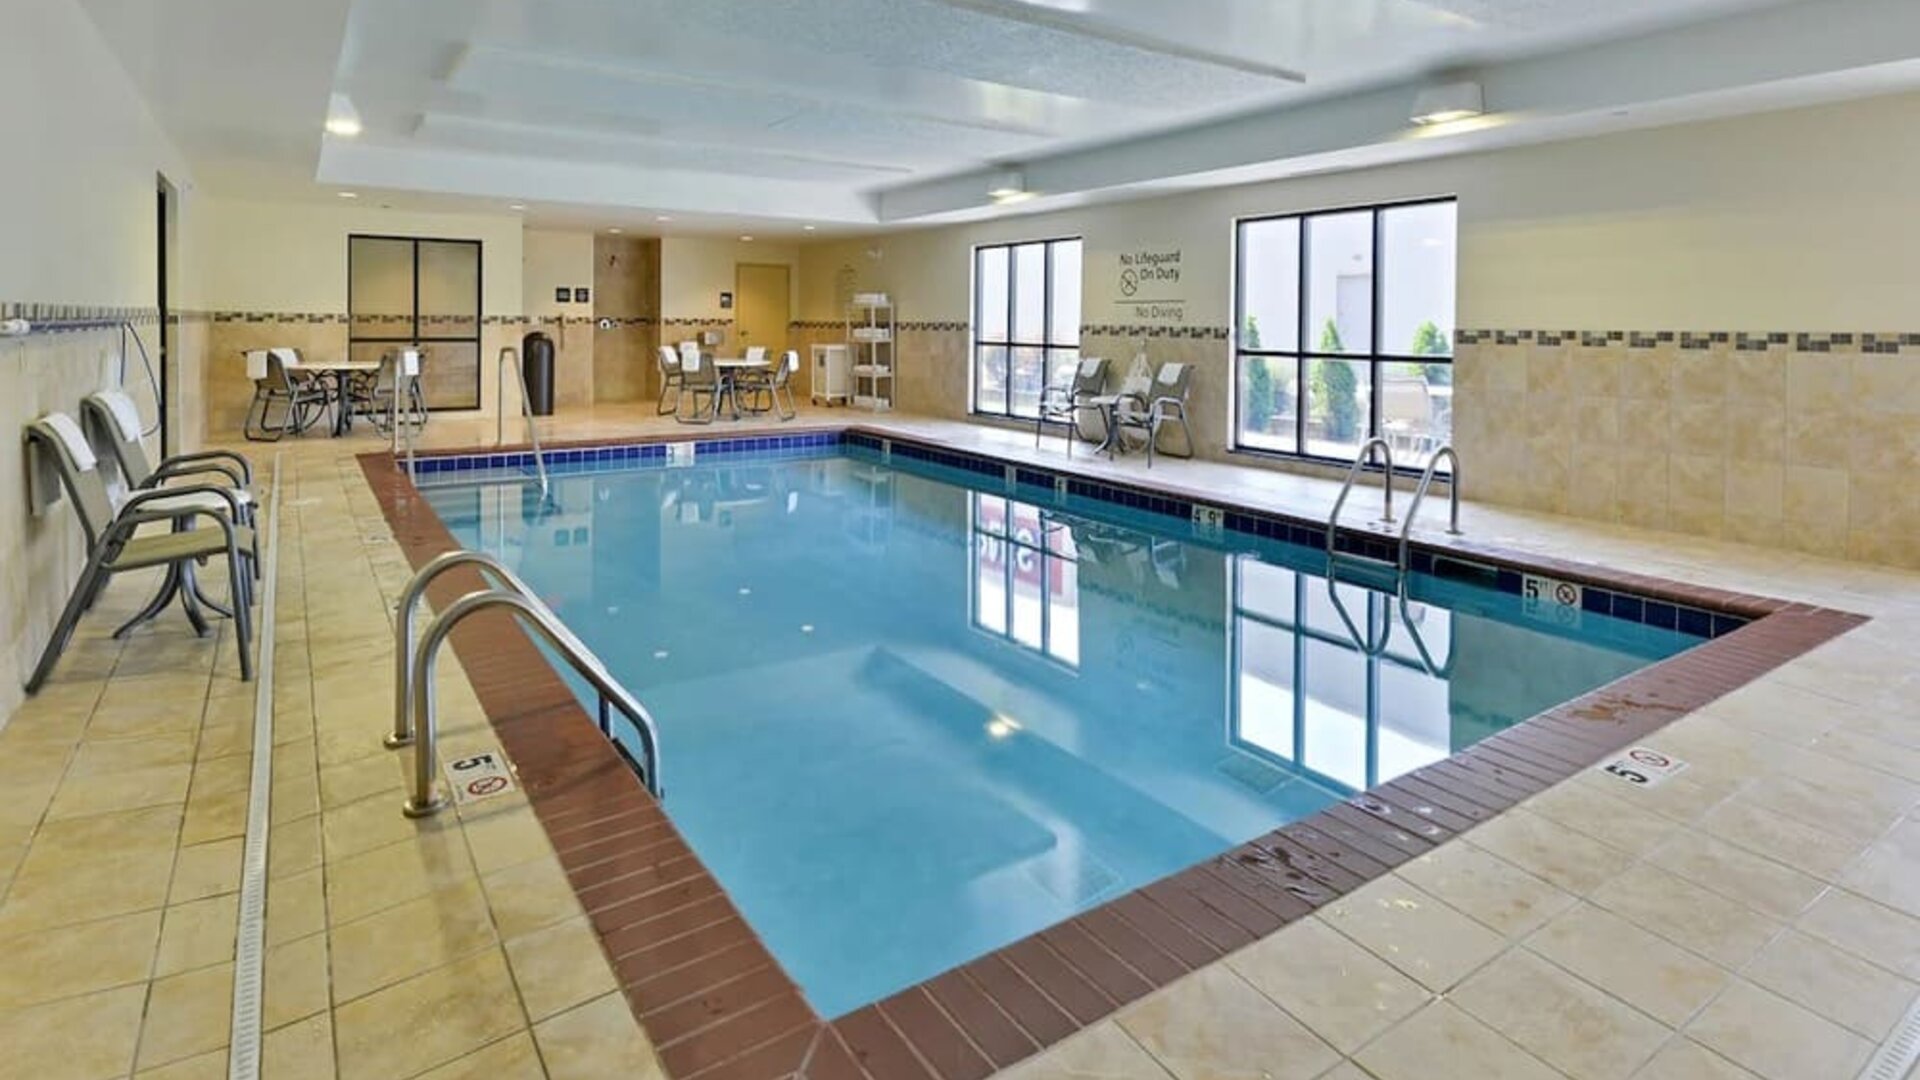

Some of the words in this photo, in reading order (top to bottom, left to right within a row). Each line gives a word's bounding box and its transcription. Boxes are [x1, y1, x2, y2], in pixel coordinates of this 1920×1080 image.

[1120, 253, 1134, 265] No
[1135, 249, 1181, 266] Lifeguard
[1140, 268, 1155, 281] On
[1156, 266, 1180, 283] Duty
[1136, 306, 1149, 318] No
[1151, 305, 1183, 321] Diving
